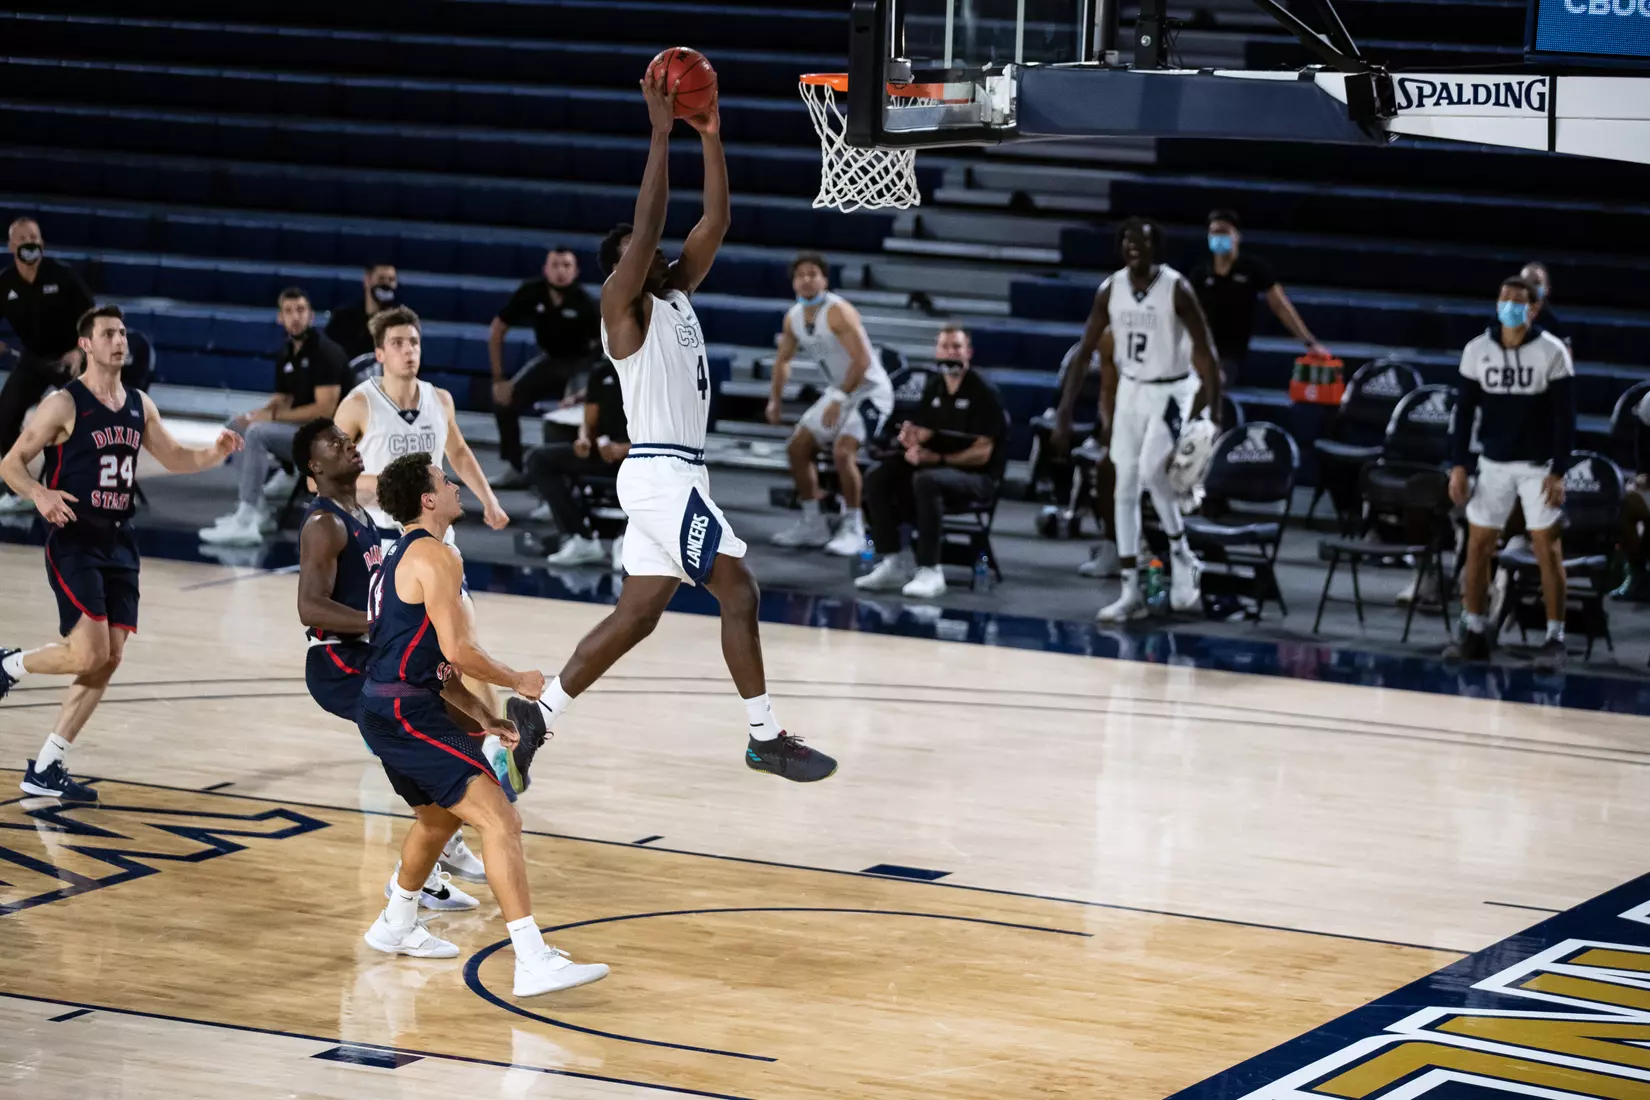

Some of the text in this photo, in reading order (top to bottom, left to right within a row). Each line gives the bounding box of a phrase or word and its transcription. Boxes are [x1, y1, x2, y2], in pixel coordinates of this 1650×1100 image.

[1397, 77, 1547, 112] SPALDING
[1127, 332, 1148, 363] 12
[697, 355, 709, 400] 4
[1485, 366, 1534, 388] CBU
[389, 432, 436, 455] CBU
[99, 454, 133, 488] 24
[686, 513, 709, 569] LANCERS
